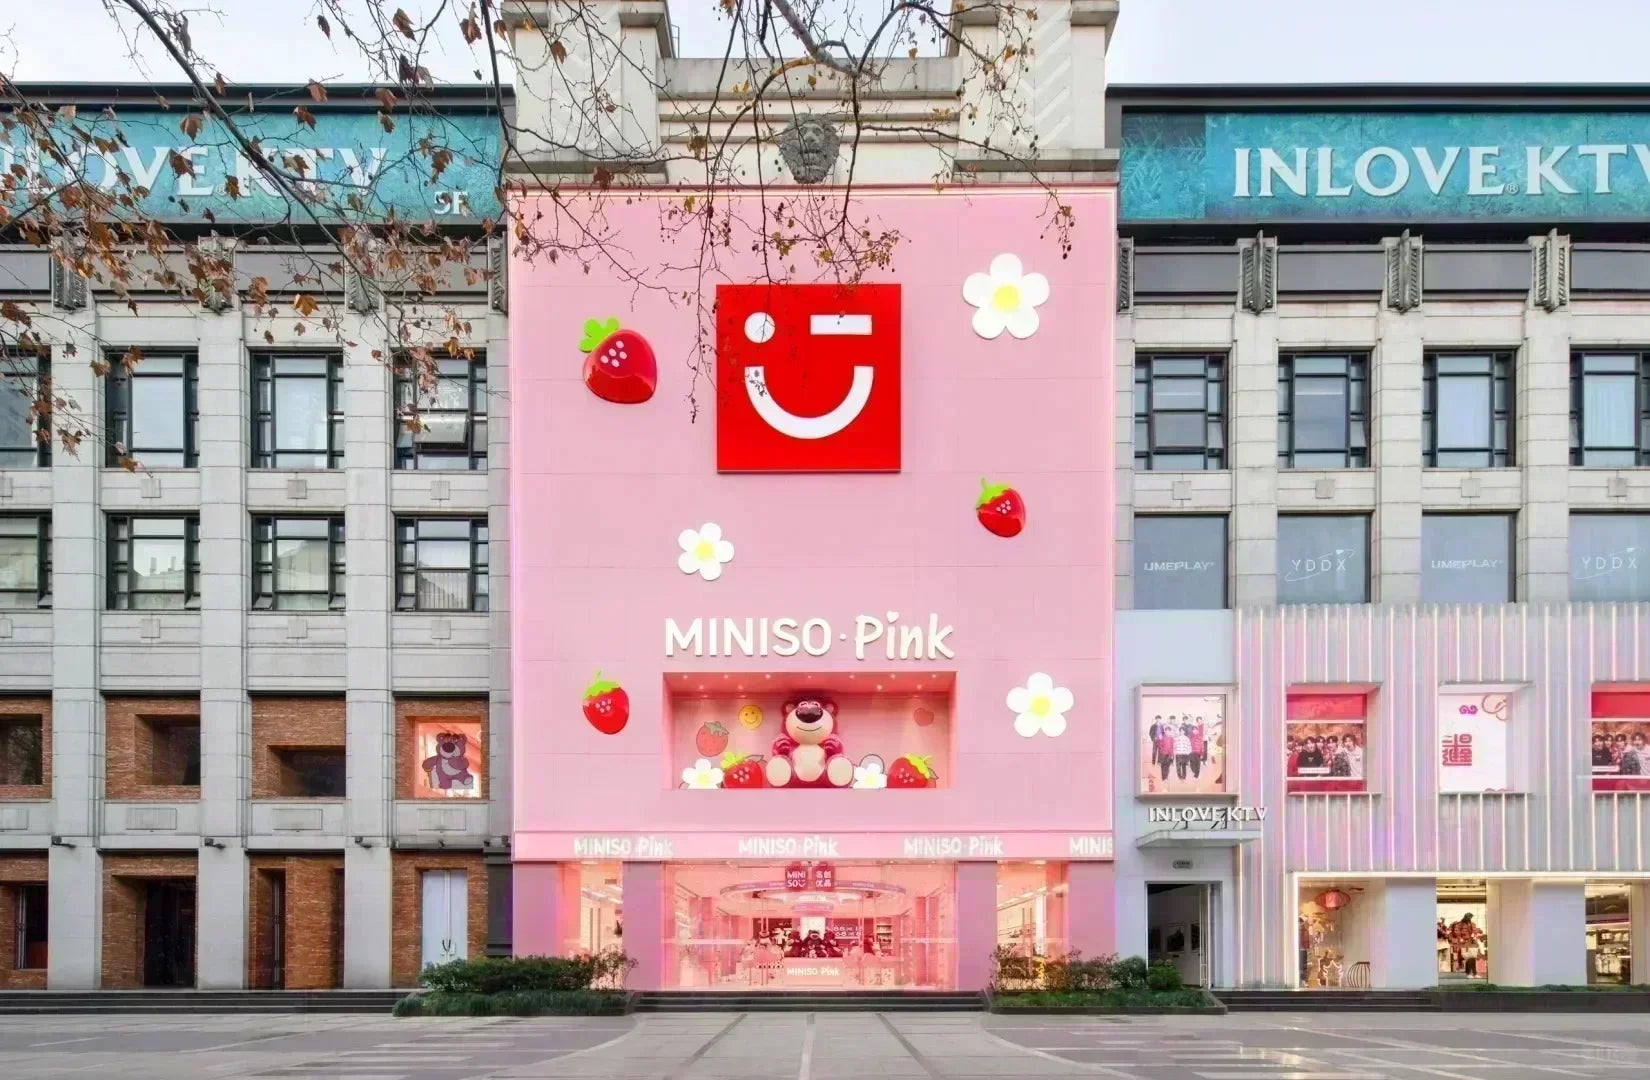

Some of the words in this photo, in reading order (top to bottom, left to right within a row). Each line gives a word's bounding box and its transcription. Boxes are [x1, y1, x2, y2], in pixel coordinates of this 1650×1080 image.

[1233, 146, 1505, 197] INLOVE
[665, 617, 832, 657] MINISO
[854, 610, 955, 661] Pink
[1227, 807, 1268, 822] KTV
[573, 837, 632, 856] MINISO
[638, 835, 673, 857] Pink
[738, 837, 797, 856] MINISO
[803, 835, 839, 857] Pink
[903, 837, 962, 856] MINISO
[969, 834, 1004, 857] Pink
[786, 968, 818, 977] MINISO
